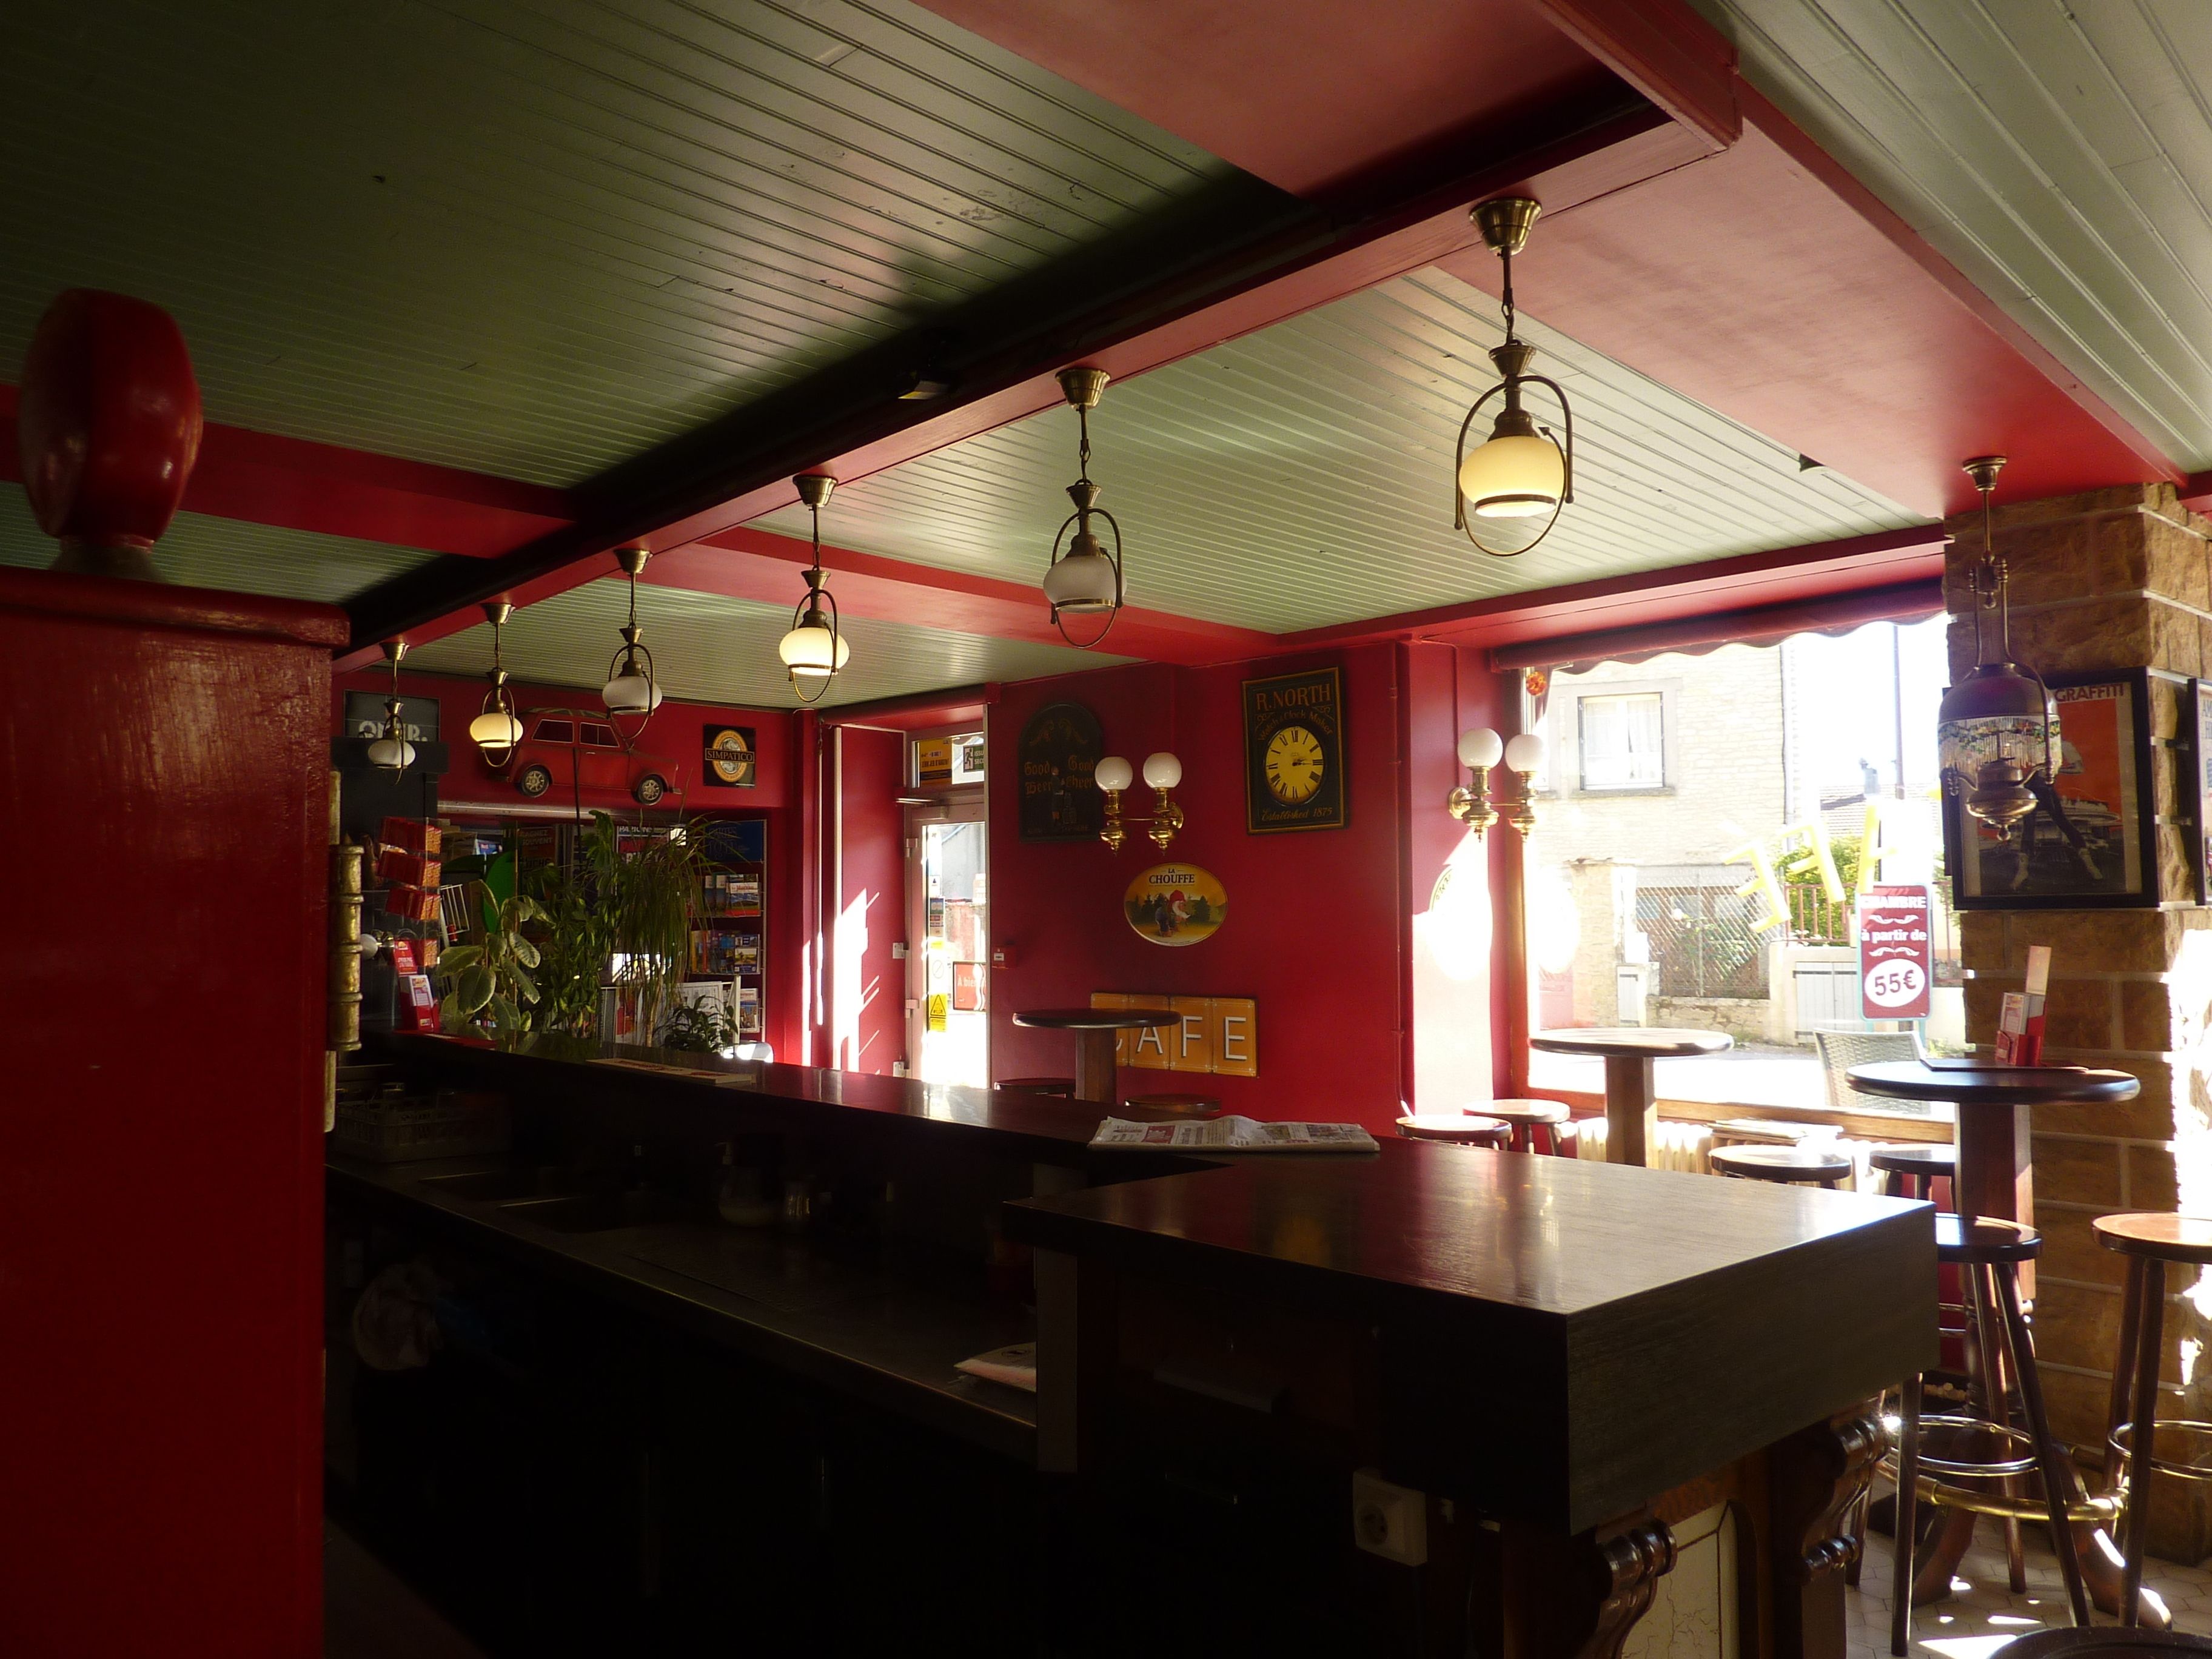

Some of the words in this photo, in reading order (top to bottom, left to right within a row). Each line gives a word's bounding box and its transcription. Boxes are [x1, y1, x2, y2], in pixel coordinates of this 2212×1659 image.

[706, 750, 752, 762] SIMPATICO
[1024, 761, 1051, 777] Good
[1261, 808, 1310, 822] Established
[1313, 806, 1333, 818] 1875
[1148, 874, 1195, 884] CHOUFFE
[1861, 929, 1870, 942] à
[1872, 928, 1909, 944] partir
[1911, 928, 1928, 942] de
[1874, 969, 1917, 996] 55€
[1116, 1014, 1247, 1061] AFE
